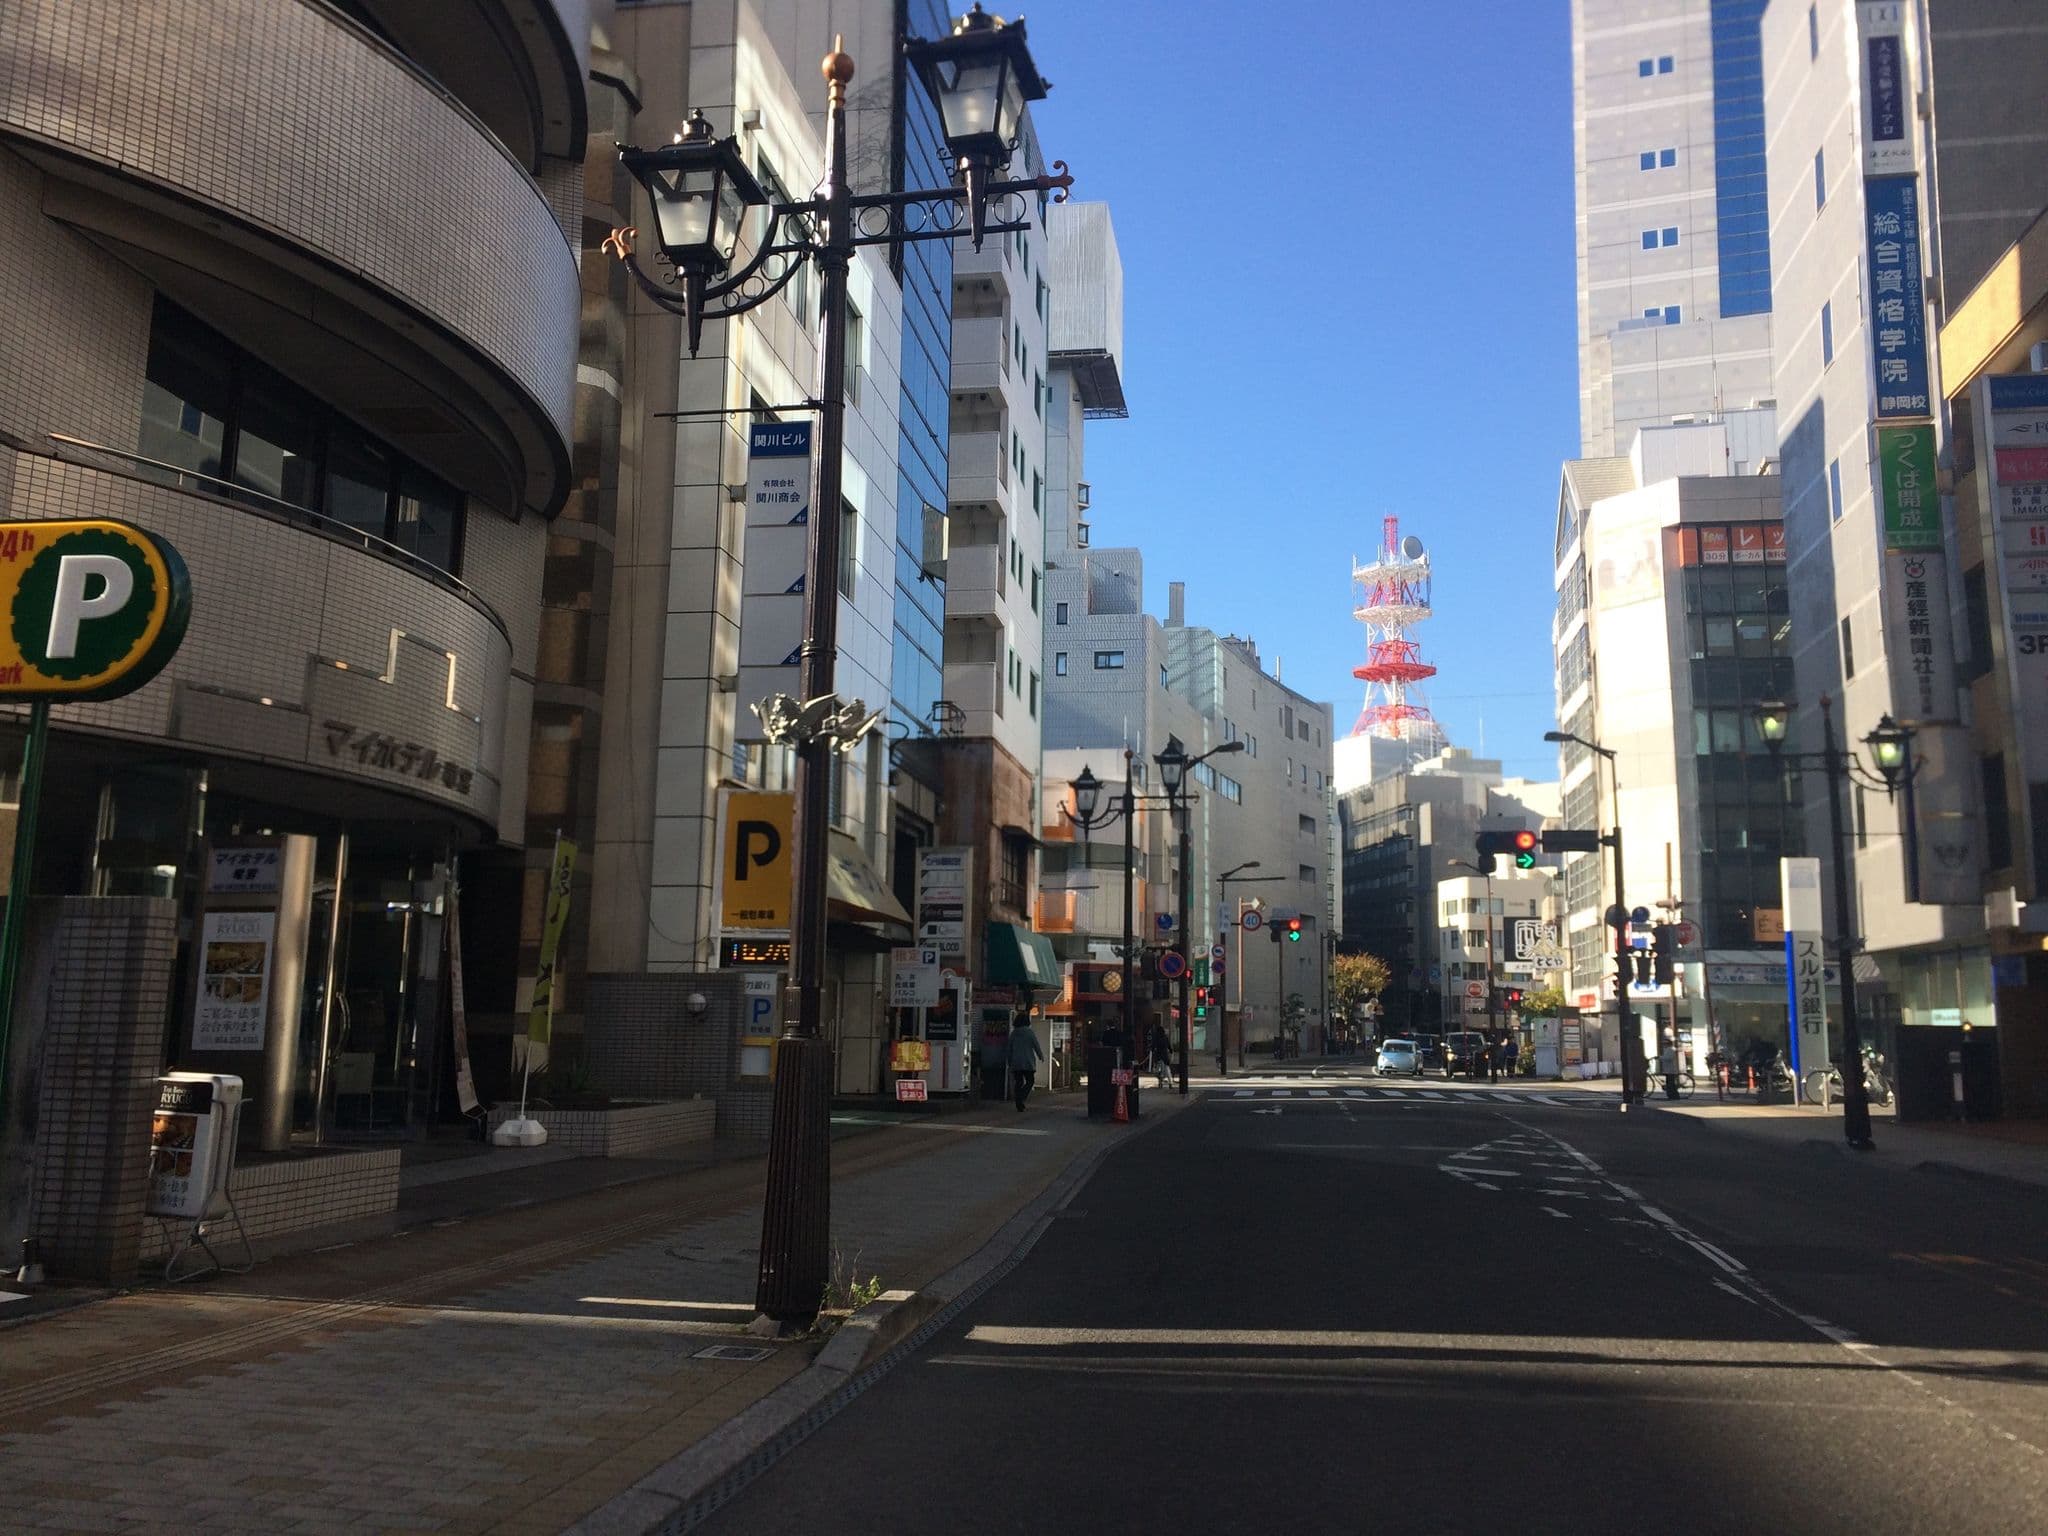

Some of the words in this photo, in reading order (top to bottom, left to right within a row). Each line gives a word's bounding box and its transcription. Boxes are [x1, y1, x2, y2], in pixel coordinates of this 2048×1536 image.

[1873, 210, 1909, 384] 総合資格学院
[1881, 394, 1927, 410] 静岡校
[754, 433, 806, 447] 関川ビル
[763, 479, 795, 487] 有限会社
[1893, 432, 1924, 528] つくば開成
[756, 491, 801, 504] 関川商会
[45, 555, 134, 659] P
[735, 820, 781, 881] P
[1245, 915, 1258, 926] 40
[752, 999, 773, 1024] P
